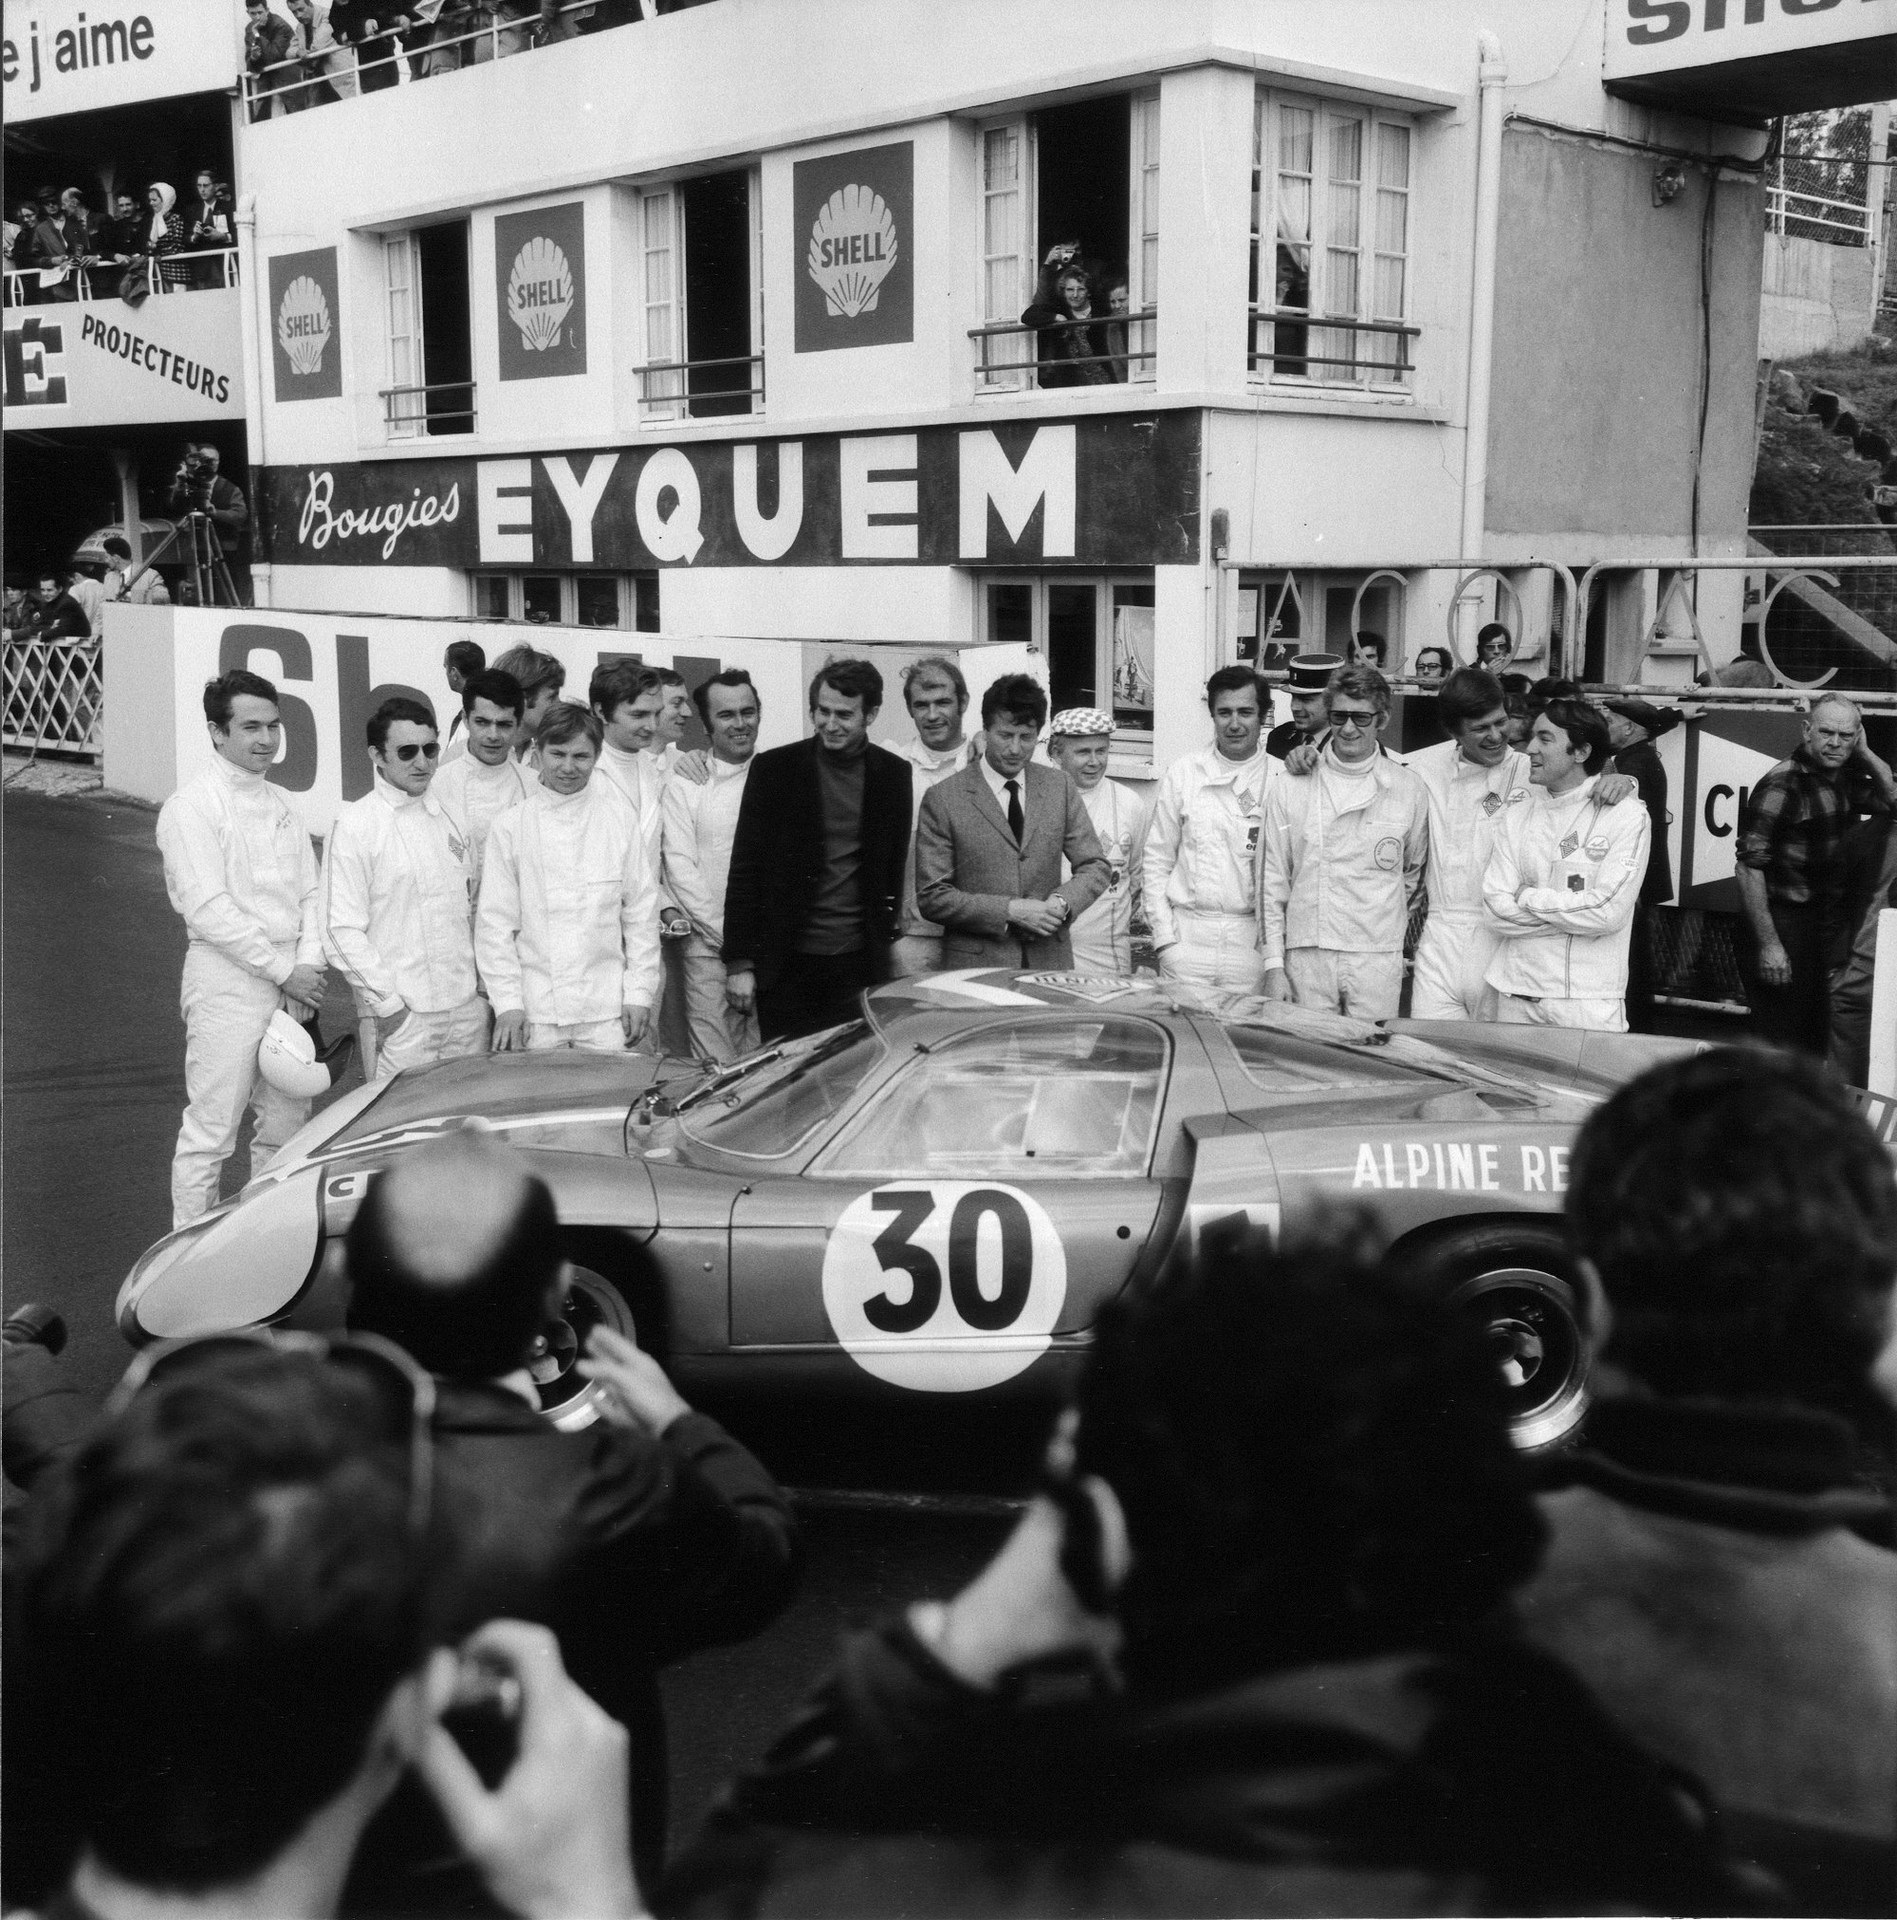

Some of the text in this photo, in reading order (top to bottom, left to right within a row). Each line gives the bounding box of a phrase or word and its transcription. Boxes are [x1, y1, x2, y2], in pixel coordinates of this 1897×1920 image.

[55, 12, 155, 73] aime
[821, 232, 886, 268] SHELL
[517, 278, 566, 310] SHELL
[286, 312, 324, 339] SHELL
[81, 314, 230, 404] PROJECTEURS
[299, 424, 1076, 565] Bougies EYQUEM
[1352, 1142, 1571, 1193] ALPINE RE
[862, 1189, 1034, 1333] 30
